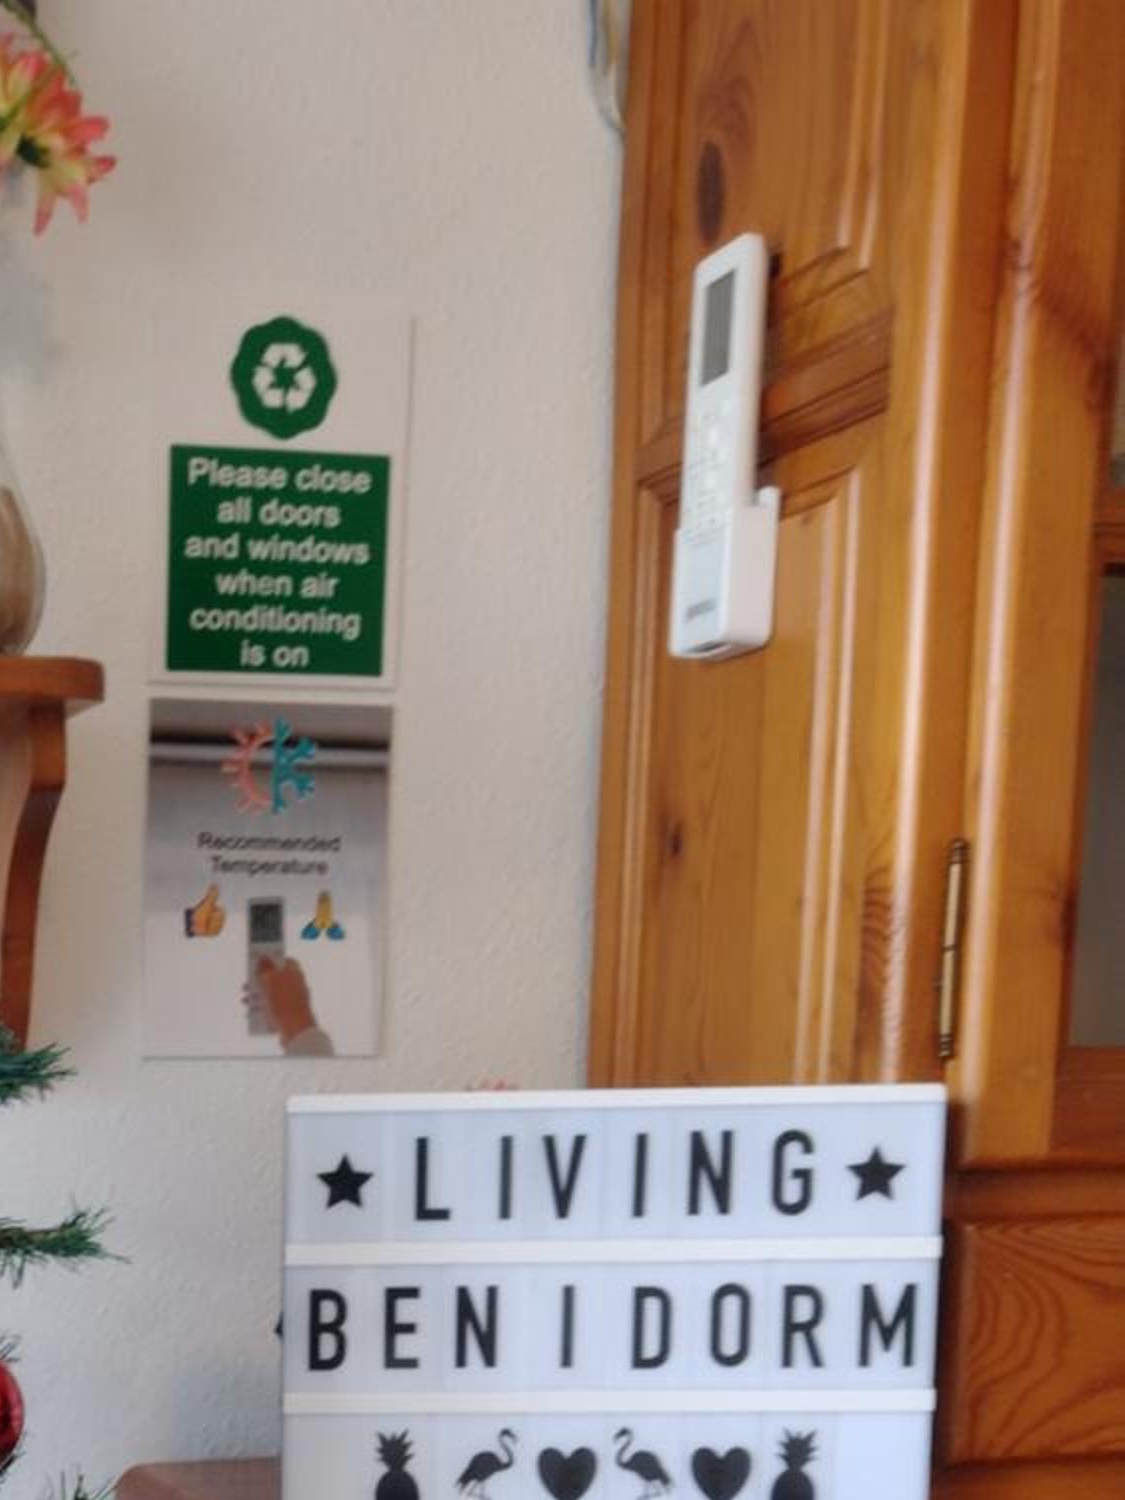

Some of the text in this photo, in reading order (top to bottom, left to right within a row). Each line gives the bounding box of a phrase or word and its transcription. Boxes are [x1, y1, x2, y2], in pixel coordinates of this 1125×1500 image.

[187, 457, 372, 494] Please close
[217, 498, 342, 528] all doors
[184, 533, 371, 565] and windows
[215, 569, 340, 599] when air
[189, 605, 362, 640] conditioning
[240, 641, 309, 668] is on
[197, 831, 342, 853] Recommended
[210, 855, 330, 876] Temperature
[413, 1129, 815, 1222] LIVING
[307, 1283, 918, 1372] BENIDORM
